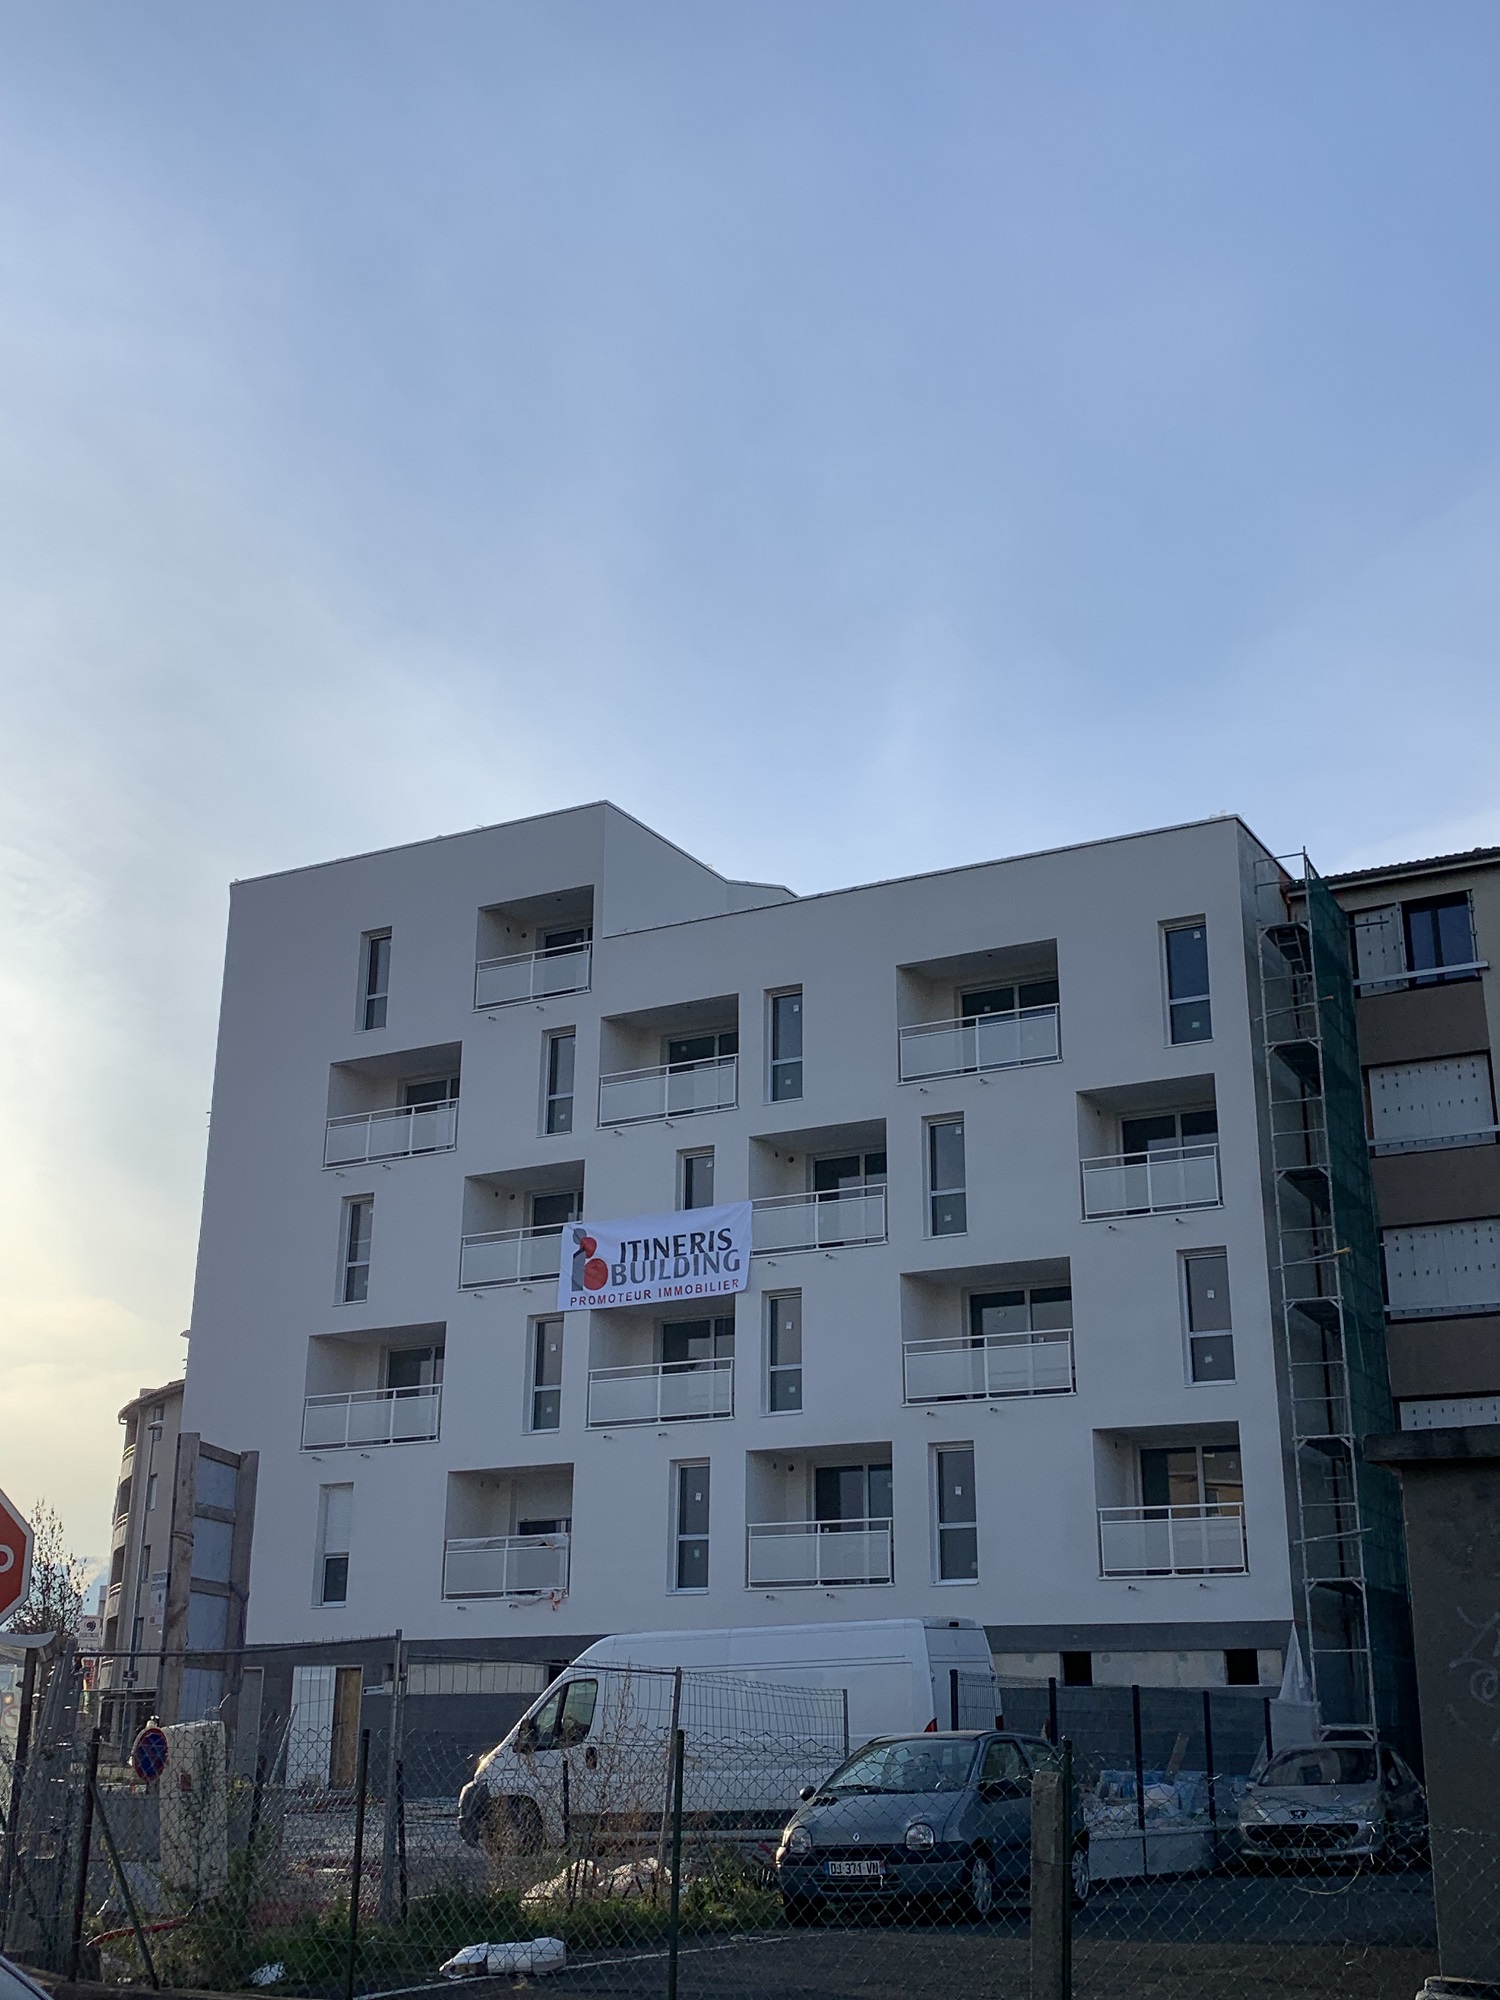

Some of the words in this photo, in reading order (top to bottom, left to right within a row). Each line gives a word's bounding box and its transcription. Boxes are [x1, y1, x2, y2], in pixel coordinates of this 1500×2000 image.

[620, 1227, 732, 1263] ITINERIS
[611, 1249, 740, 1287] BUILDING
[570, 1289, 651, 1306] PROMOTEUR
[658, 1278, 739, 1298] IMMOBILIER
